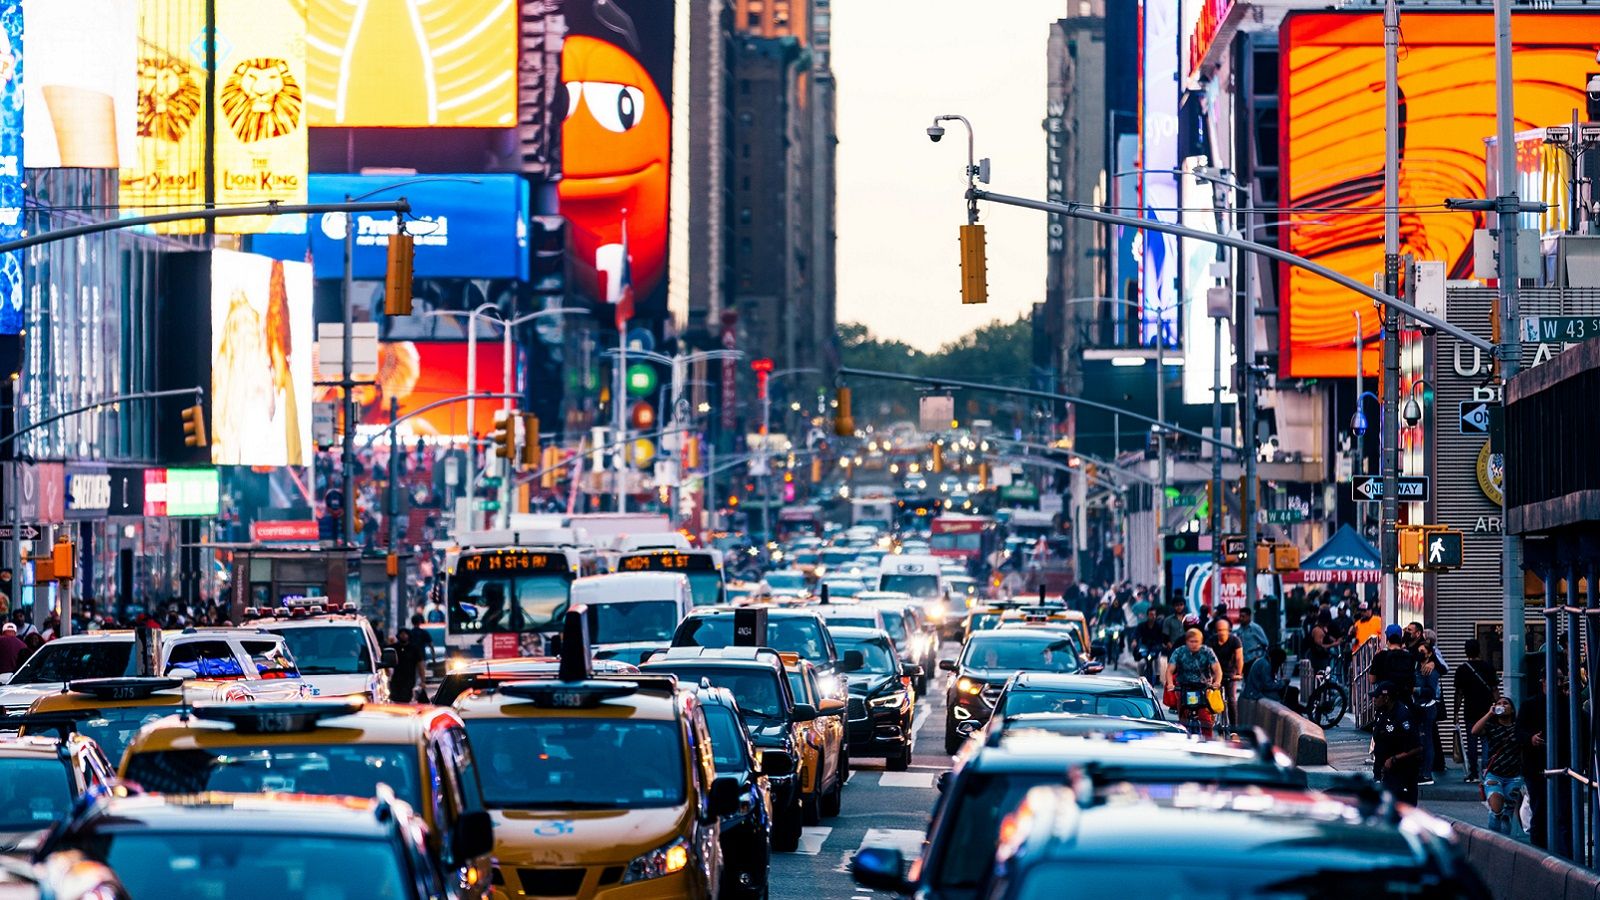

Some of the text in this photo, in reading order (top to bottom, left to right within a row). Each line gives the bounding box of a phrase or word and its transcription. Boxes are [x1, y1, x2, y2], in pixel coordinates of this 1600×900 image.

[357, 215, 448, 235] Prudntial
[1543, 320, 1557, 339] W
[1566, 319, 1585, 338] 43
[1303, 570, 1381, 582] COVID-19 TESTI
[113, 687, 135, 698] 2J75
